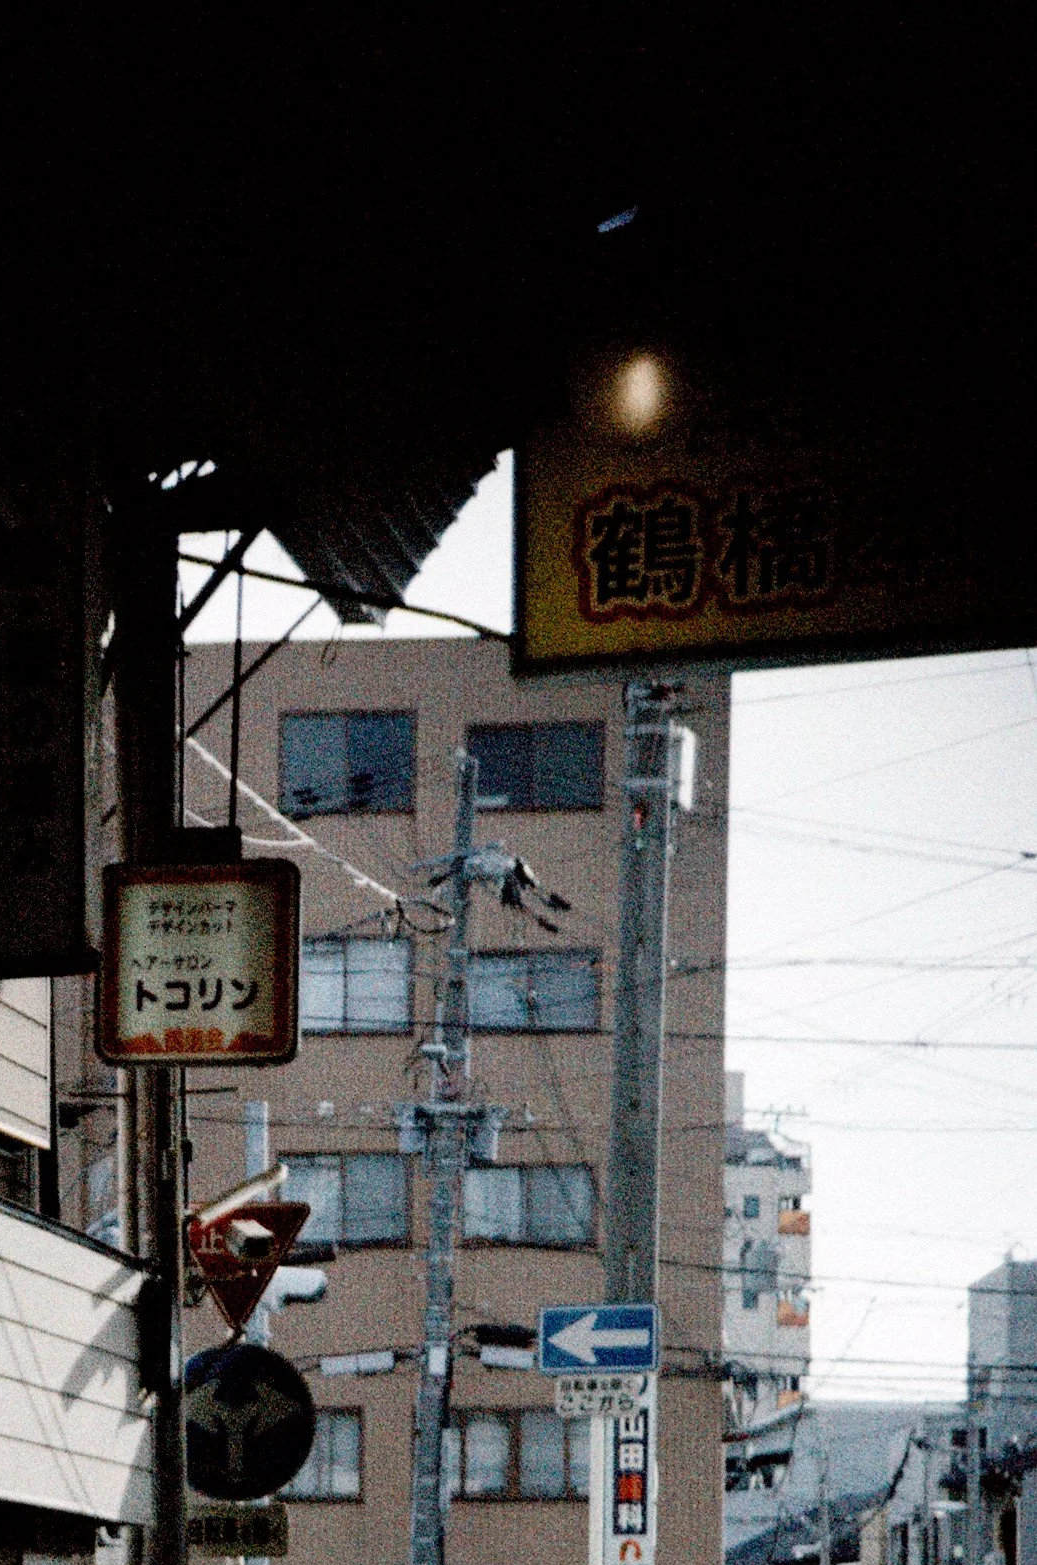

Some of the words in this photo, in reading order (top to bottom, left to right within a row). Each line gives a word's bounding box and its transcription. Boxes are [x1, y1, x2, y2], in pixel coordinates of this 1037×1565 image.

[136, 979, 258, 1011] トコリン
[560, 1393, 634, 1412] ここから
